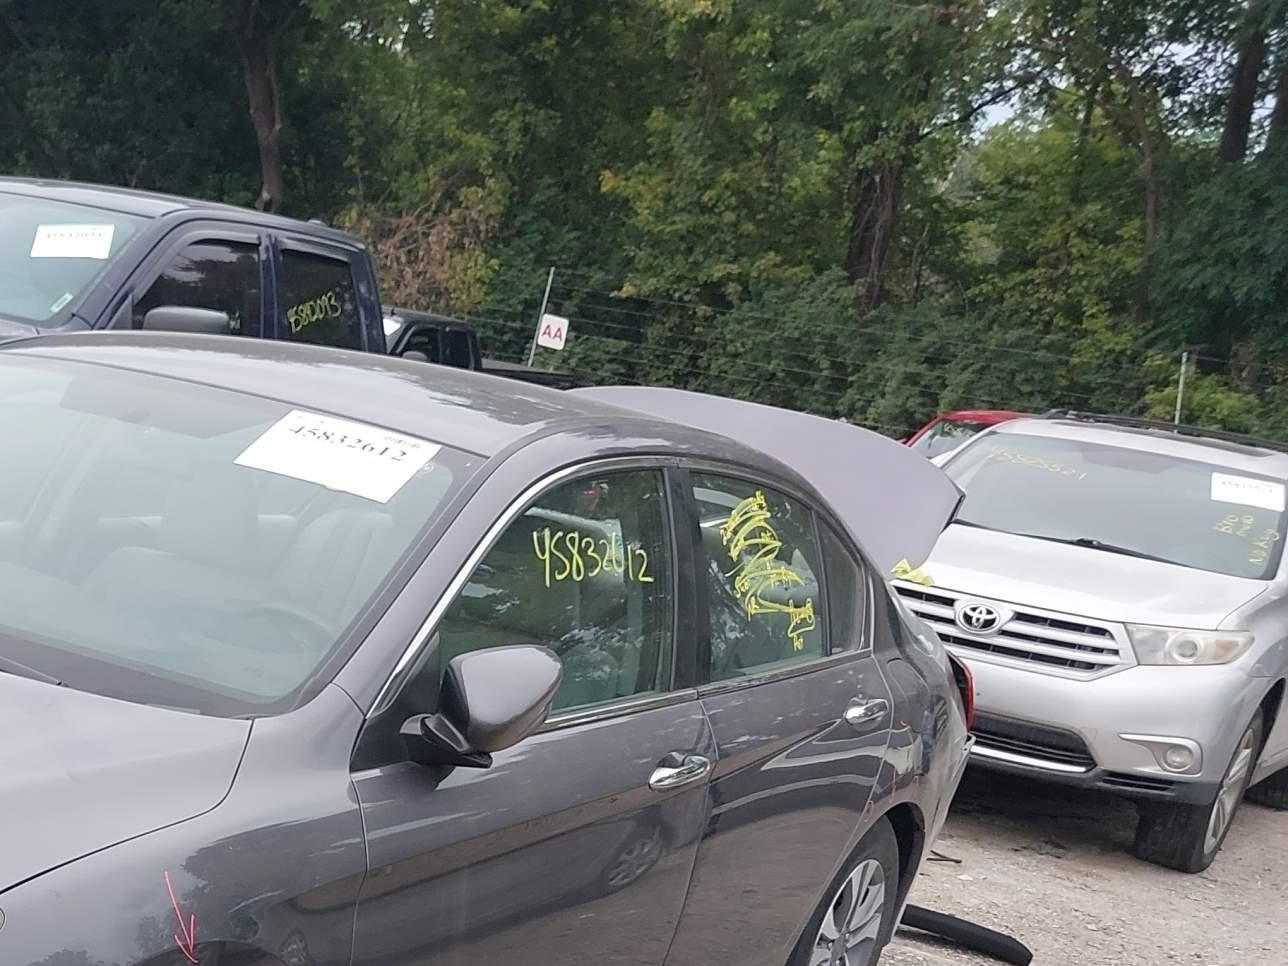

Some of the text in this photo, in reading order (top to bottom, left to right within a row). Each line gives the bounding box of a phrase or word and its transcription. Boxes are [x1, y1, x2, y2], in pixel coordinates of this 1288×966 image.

[541, 324, 562, 342] AA
[289, 425, 408, 462] 45832612
[532, 527, 655, 588] 45832612
